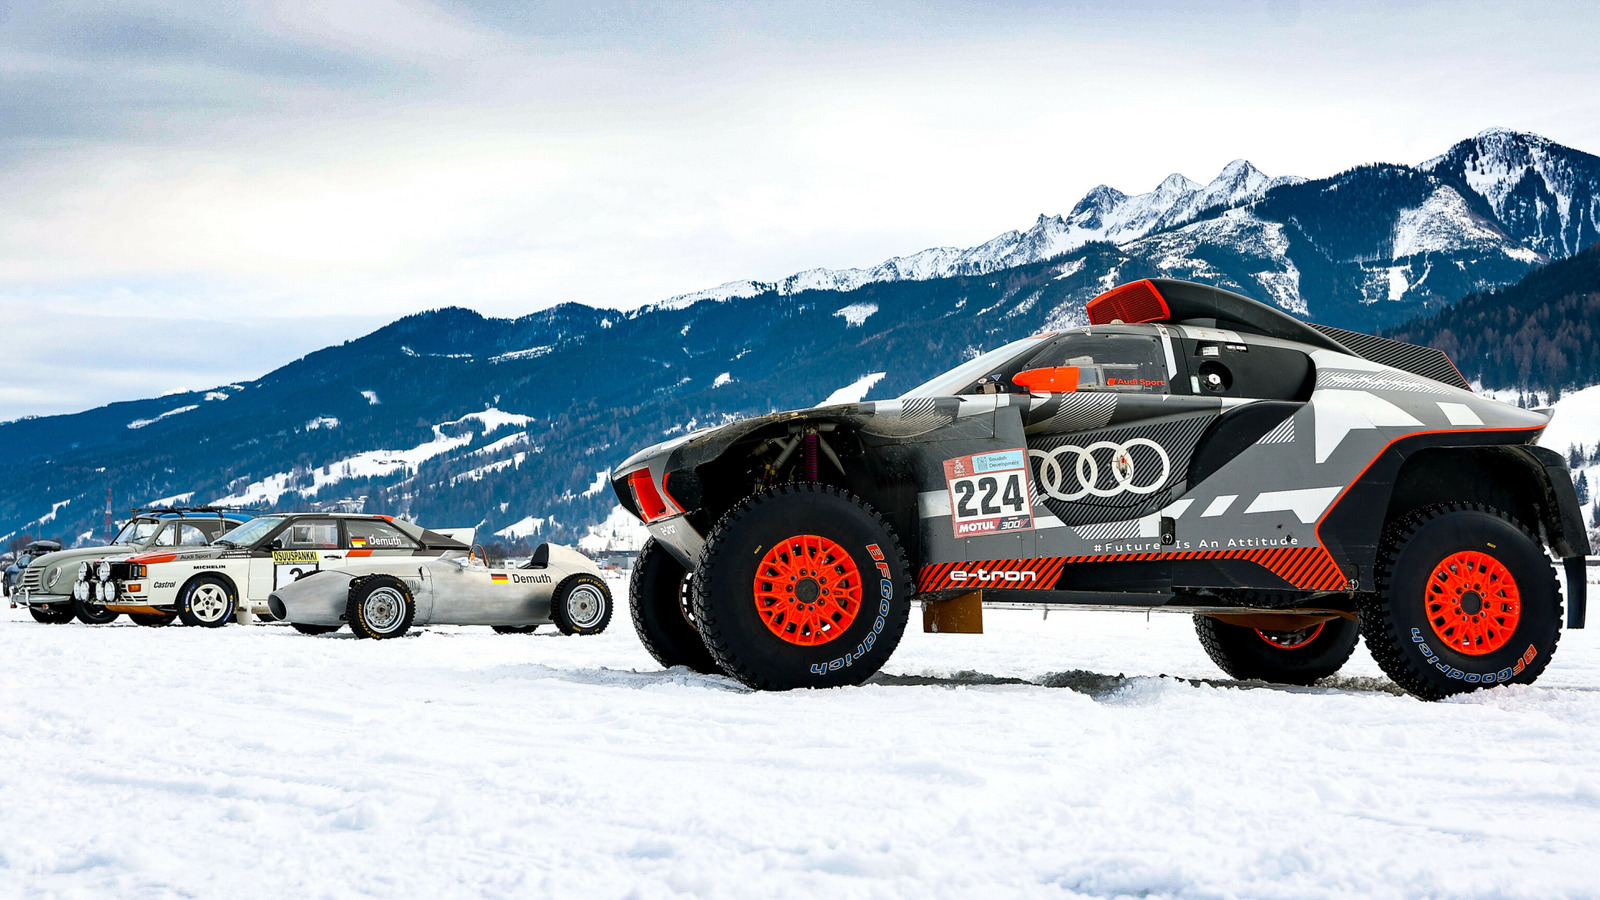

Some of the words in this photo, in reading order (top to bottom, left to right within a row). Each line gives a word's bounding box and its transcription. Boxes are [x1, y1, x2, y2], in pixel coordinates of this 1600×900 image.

[1139, 378, 1165, 387] Sport
[989, 460, 1020, 468] Development
[954, 474, 1024, 518] 224
[959, 521, 996, 533] MOTUL
[1001, 518, 1029, 530] 300V
[369, 536, 402, 545] Demuth
[1094, 541, 1161, 553] #Future
[1175, 540, 1191, 549] Is
[1199, 539, 1219, 548] An
[1227, 536, 1299, 548] Attitude
[274, 551, 318, 561] OSUUSPANKKI
[512, 574, 552, 583] Demuth
[950, 568, 1036, 581] e-tron
[153, 581, 176, 589] Castrol
[810, 543, 893, 675] BFGoodrich
[1411, 627, 1537, 683] BFGoodrich
